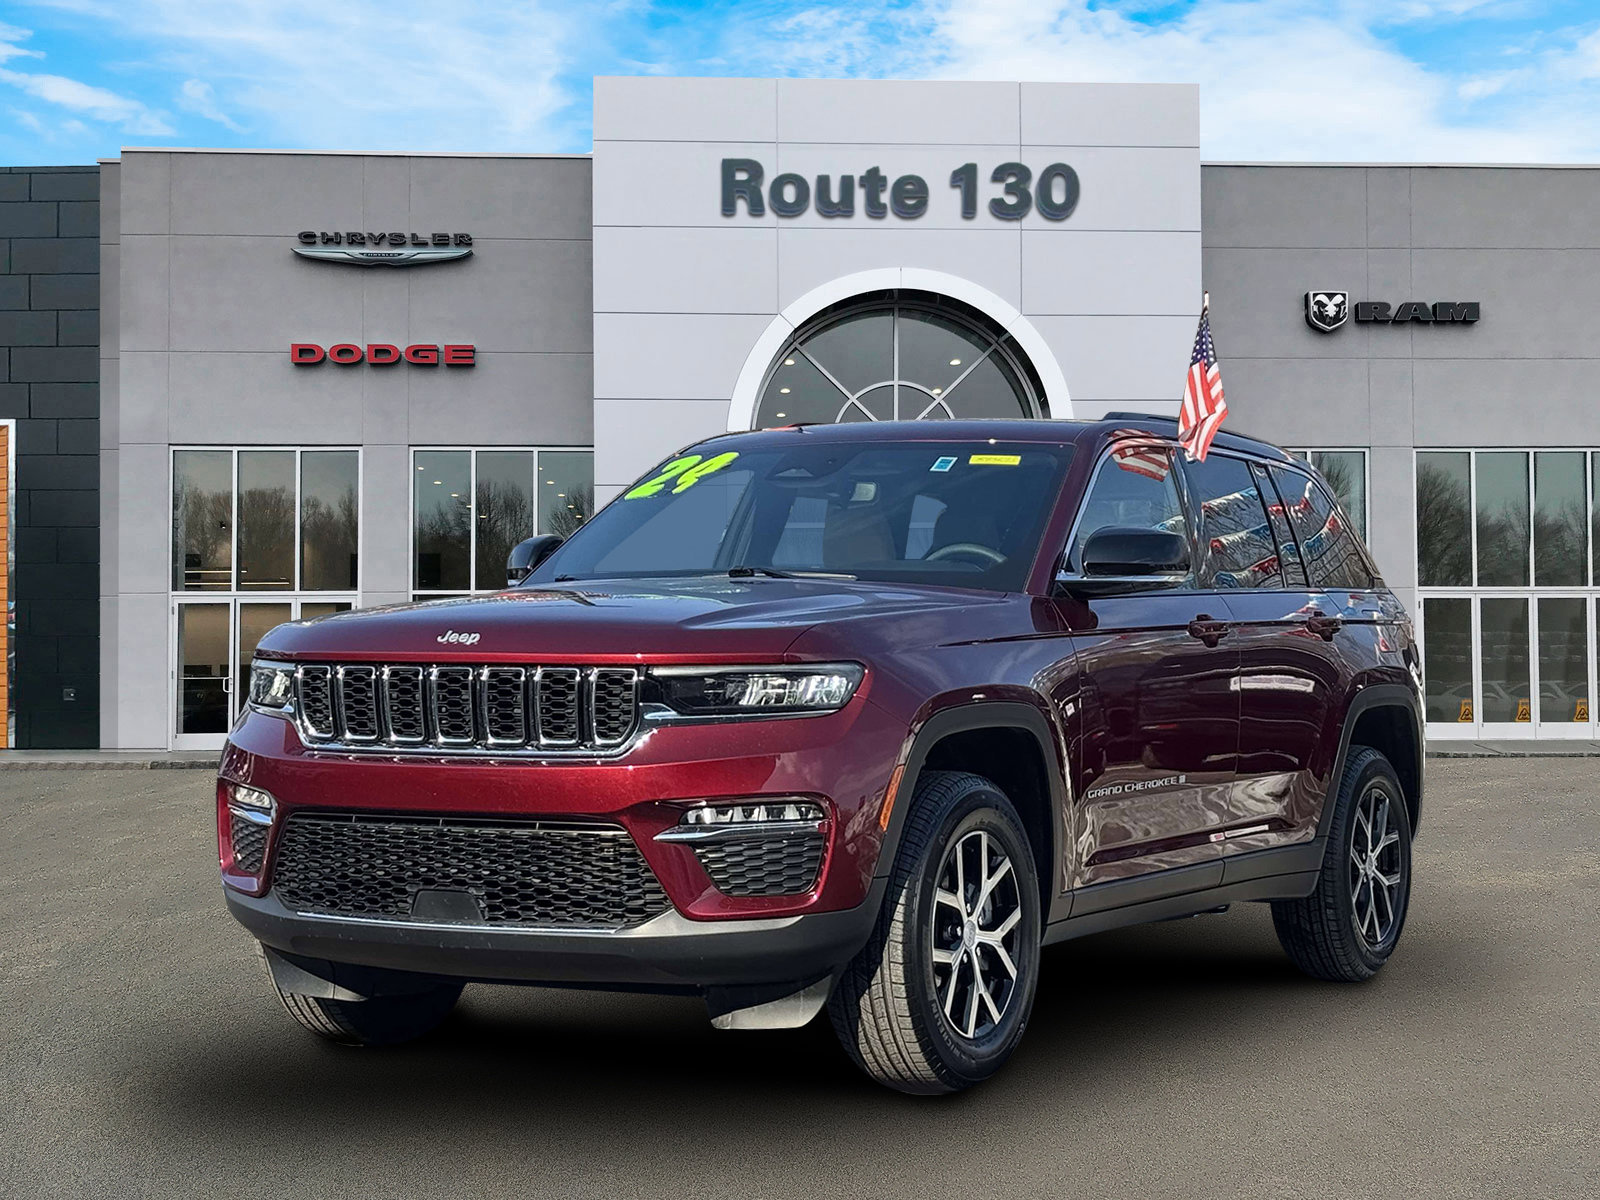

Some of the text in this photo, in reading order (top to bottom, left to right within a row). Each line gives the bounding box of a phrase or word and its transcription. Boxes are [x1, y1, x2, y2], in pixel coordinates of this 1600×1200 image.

[721, 158, 1080, 220] Route 130
[298, 231, 473, 245] CHRYSLER
[1355, 302, 1480, 323] RAM
[291, 343, 475, 364] DODGE
[437, 630, 480, 645] Jeep
[1087, 776, 1177, 799] GRAND CHEROKEE
